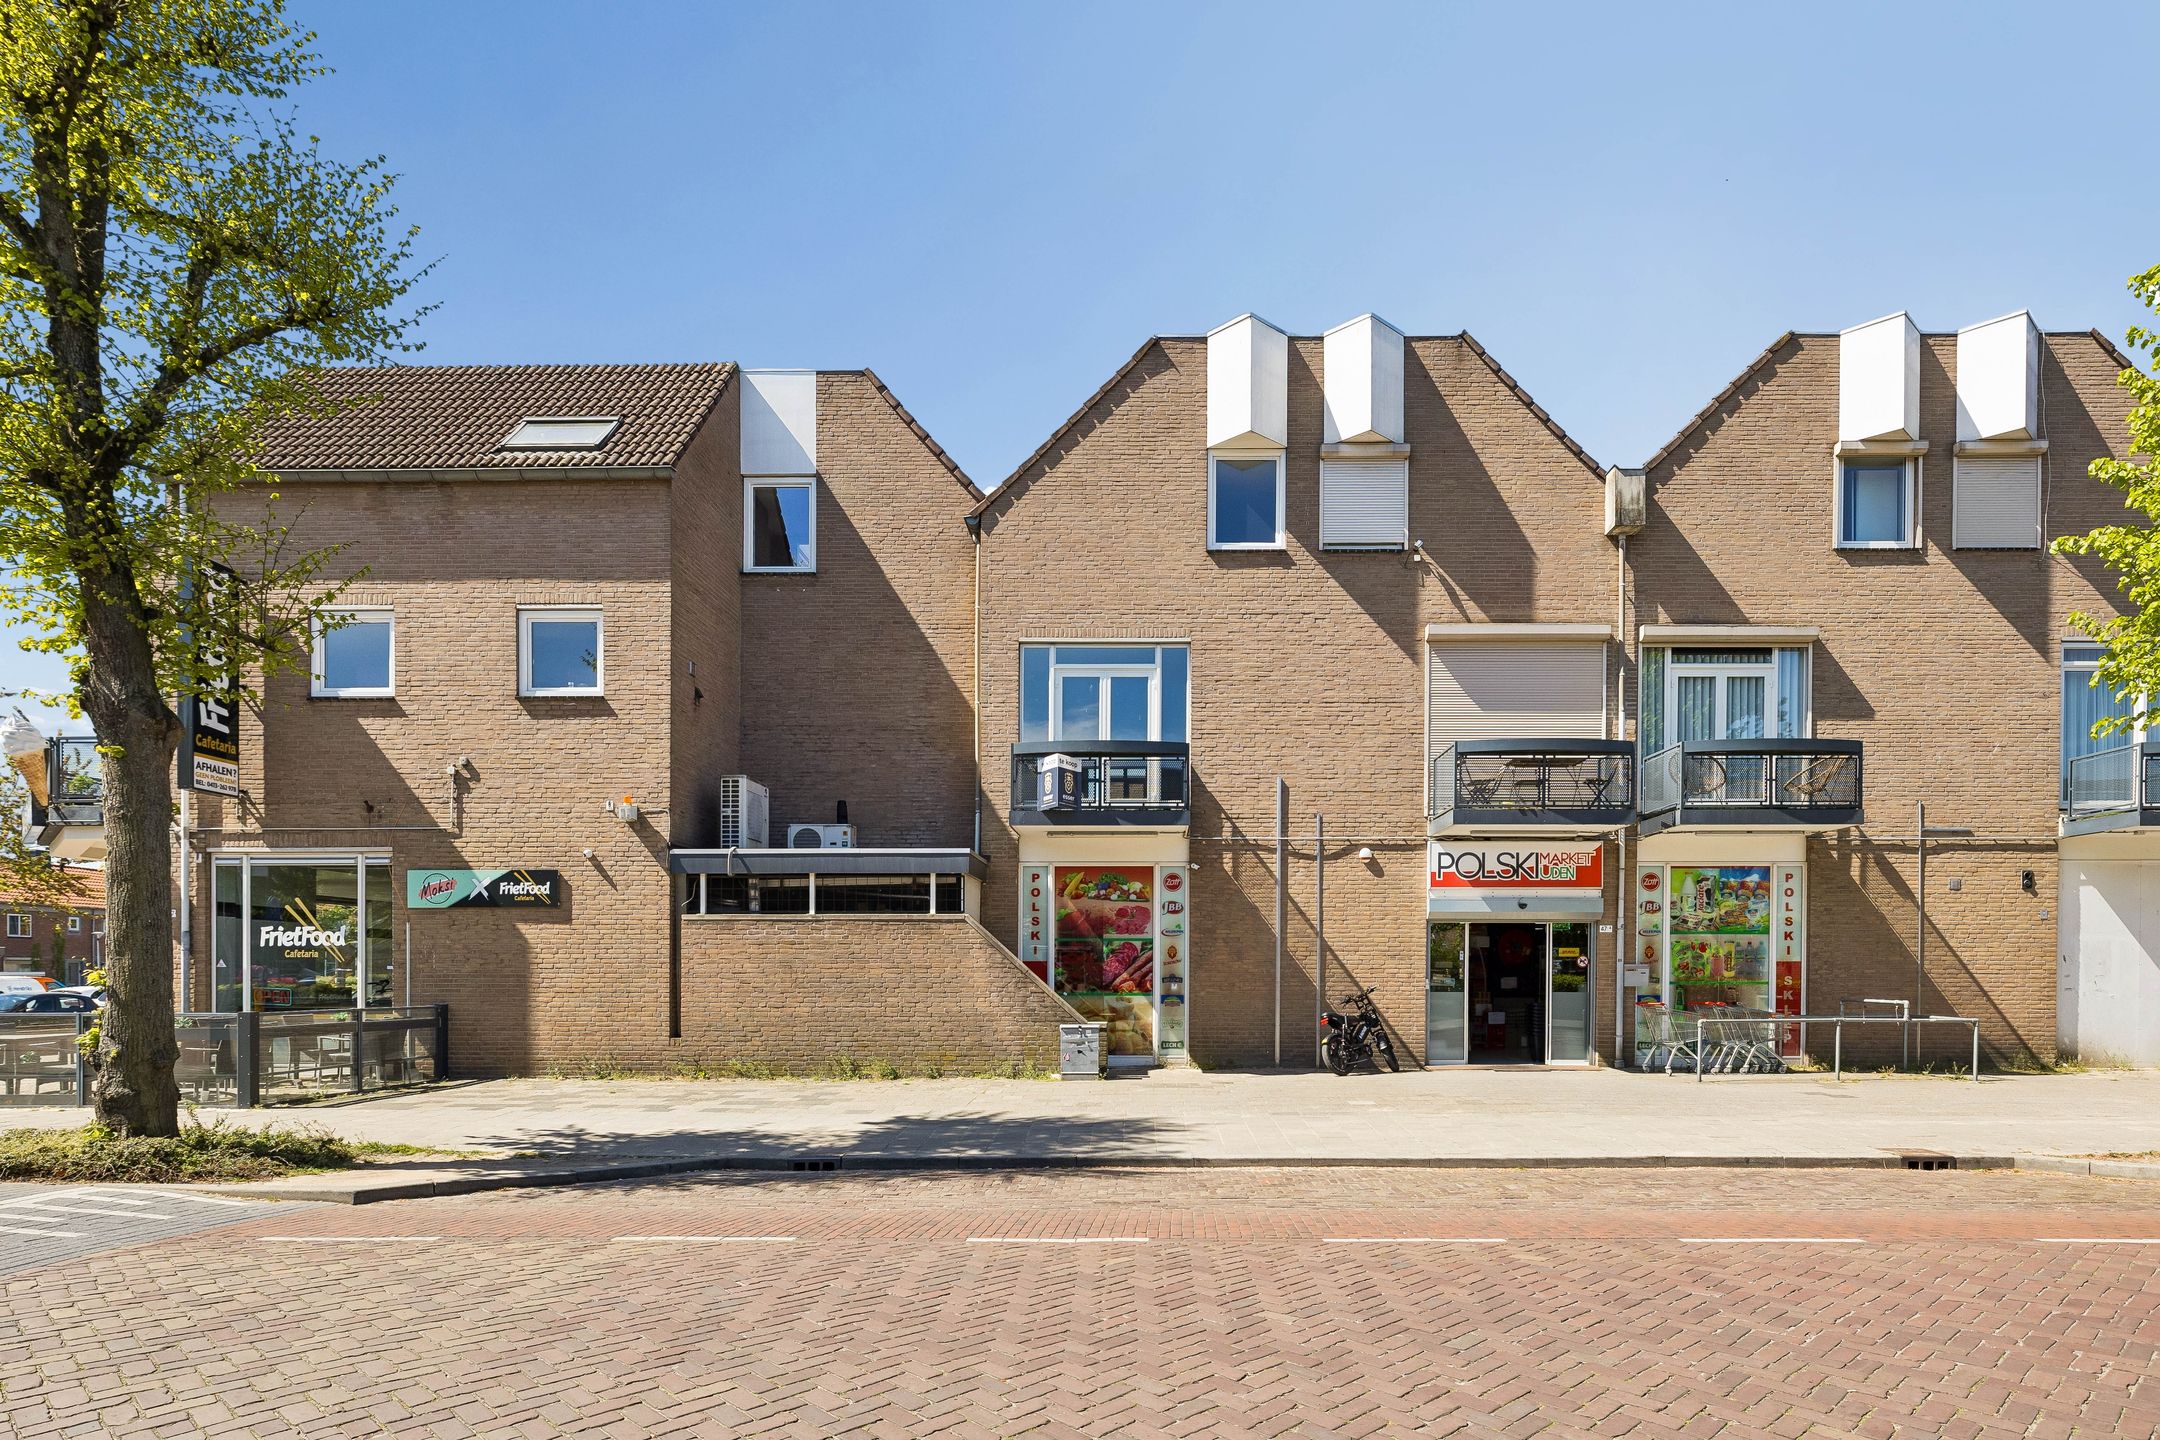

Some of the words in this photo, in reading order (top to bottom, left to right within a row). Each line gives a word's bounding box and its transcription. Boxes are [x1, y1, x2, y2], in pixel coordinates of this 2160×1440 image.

[195, 733, 236, 754] Cafetaria
[195, 761, 237, 777] AFHALEN?
[1437, 851, 1540, 880] POLSKI
[1539, 852, 1595, 865] MARKET
[1539, 866, 1576, 879] UDEN
[420, 877, 456, 900] Moksi
[499, 881, 551, 895] FrietFood
[1030, 873, 1041, 955] POLSKI
[1783, 873, 1794, 955] POLSKI
[260, 925, 347, 947] FrietFood
[284, 949, 319, 958] Cafetaria
